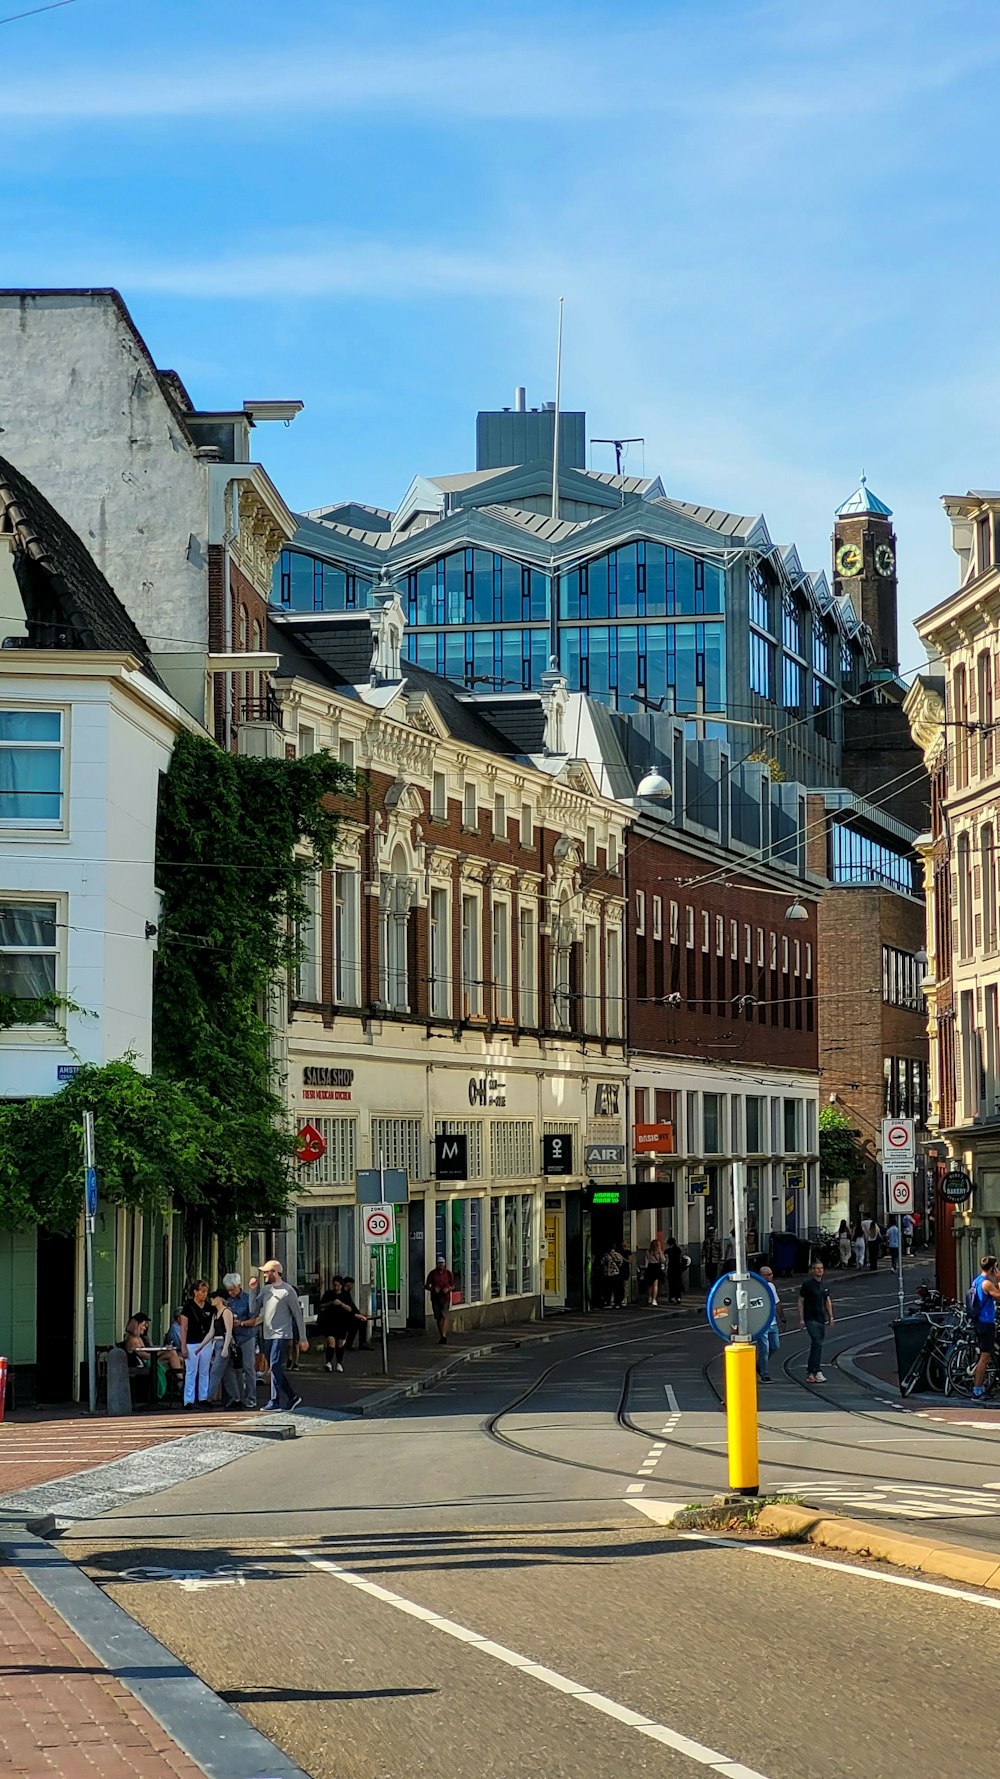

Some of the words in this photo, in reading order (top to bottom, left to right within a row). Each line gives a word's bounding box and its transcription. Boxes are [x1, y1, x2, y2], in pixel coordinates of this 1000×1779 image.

[303, 1066, 331, 1085] SALSA
[330, 1068, 354, 1087] SHOP
[588, 1149, 617, 1161] AIR
[896, 1188, 907, 1198] 30
[371, 1220, 386, 1229] 30
